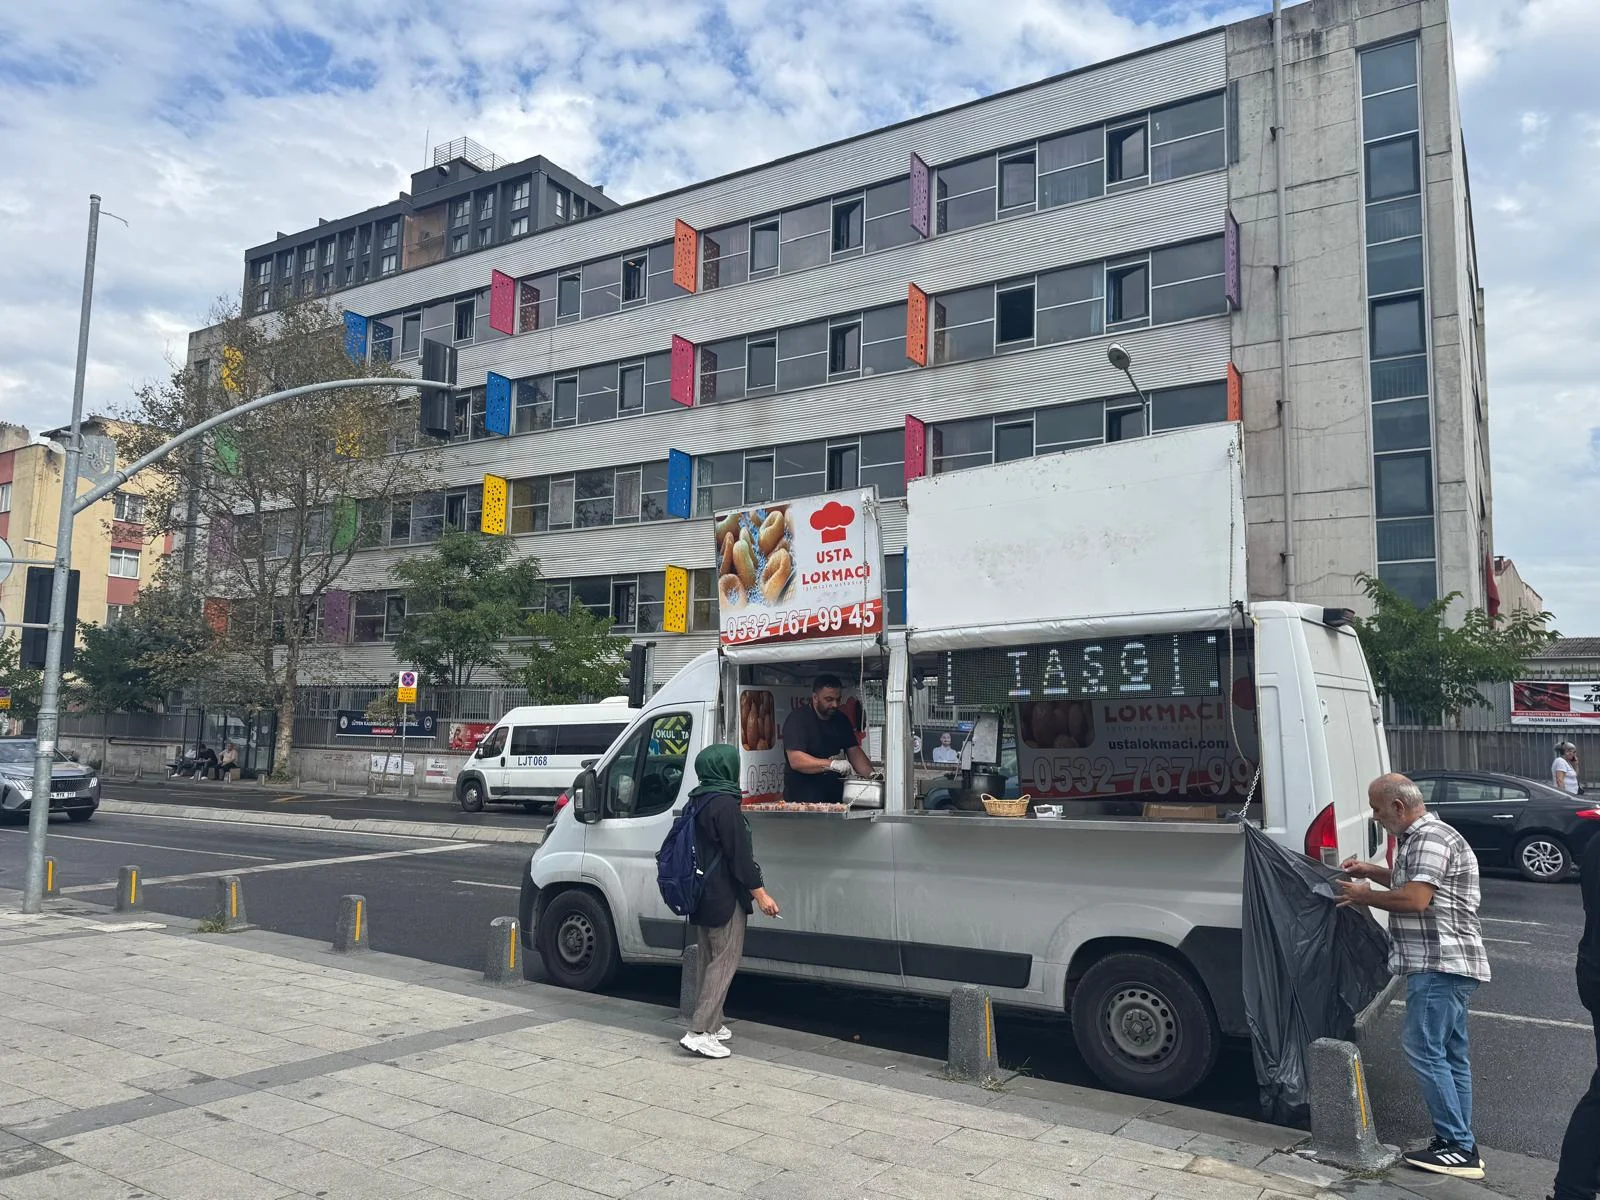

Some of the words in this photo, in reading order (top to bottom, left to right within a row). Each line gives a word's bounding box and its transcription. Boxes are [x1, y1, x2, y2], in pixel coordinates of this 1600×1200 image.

[816, 548, 852, 563] USTA
[802, 565, 870, 585] LOKMACI
[726, 614, 770, 640] 0532
[776, 608, 811, 635] 767
[817, 606, 842, 632] 99
[848, 602, 875, 629] 45
[1103, 702, 1223, 722] LOKMACI
[655, 729, 675, 739] OKUL
[1108, 737, 1229, 750] ustalokmaci.com
[1033, 757, 1117, 794] 0532
[1125, 757, 1195, 795] 767
[1207, 757, 1254, 796] 99
